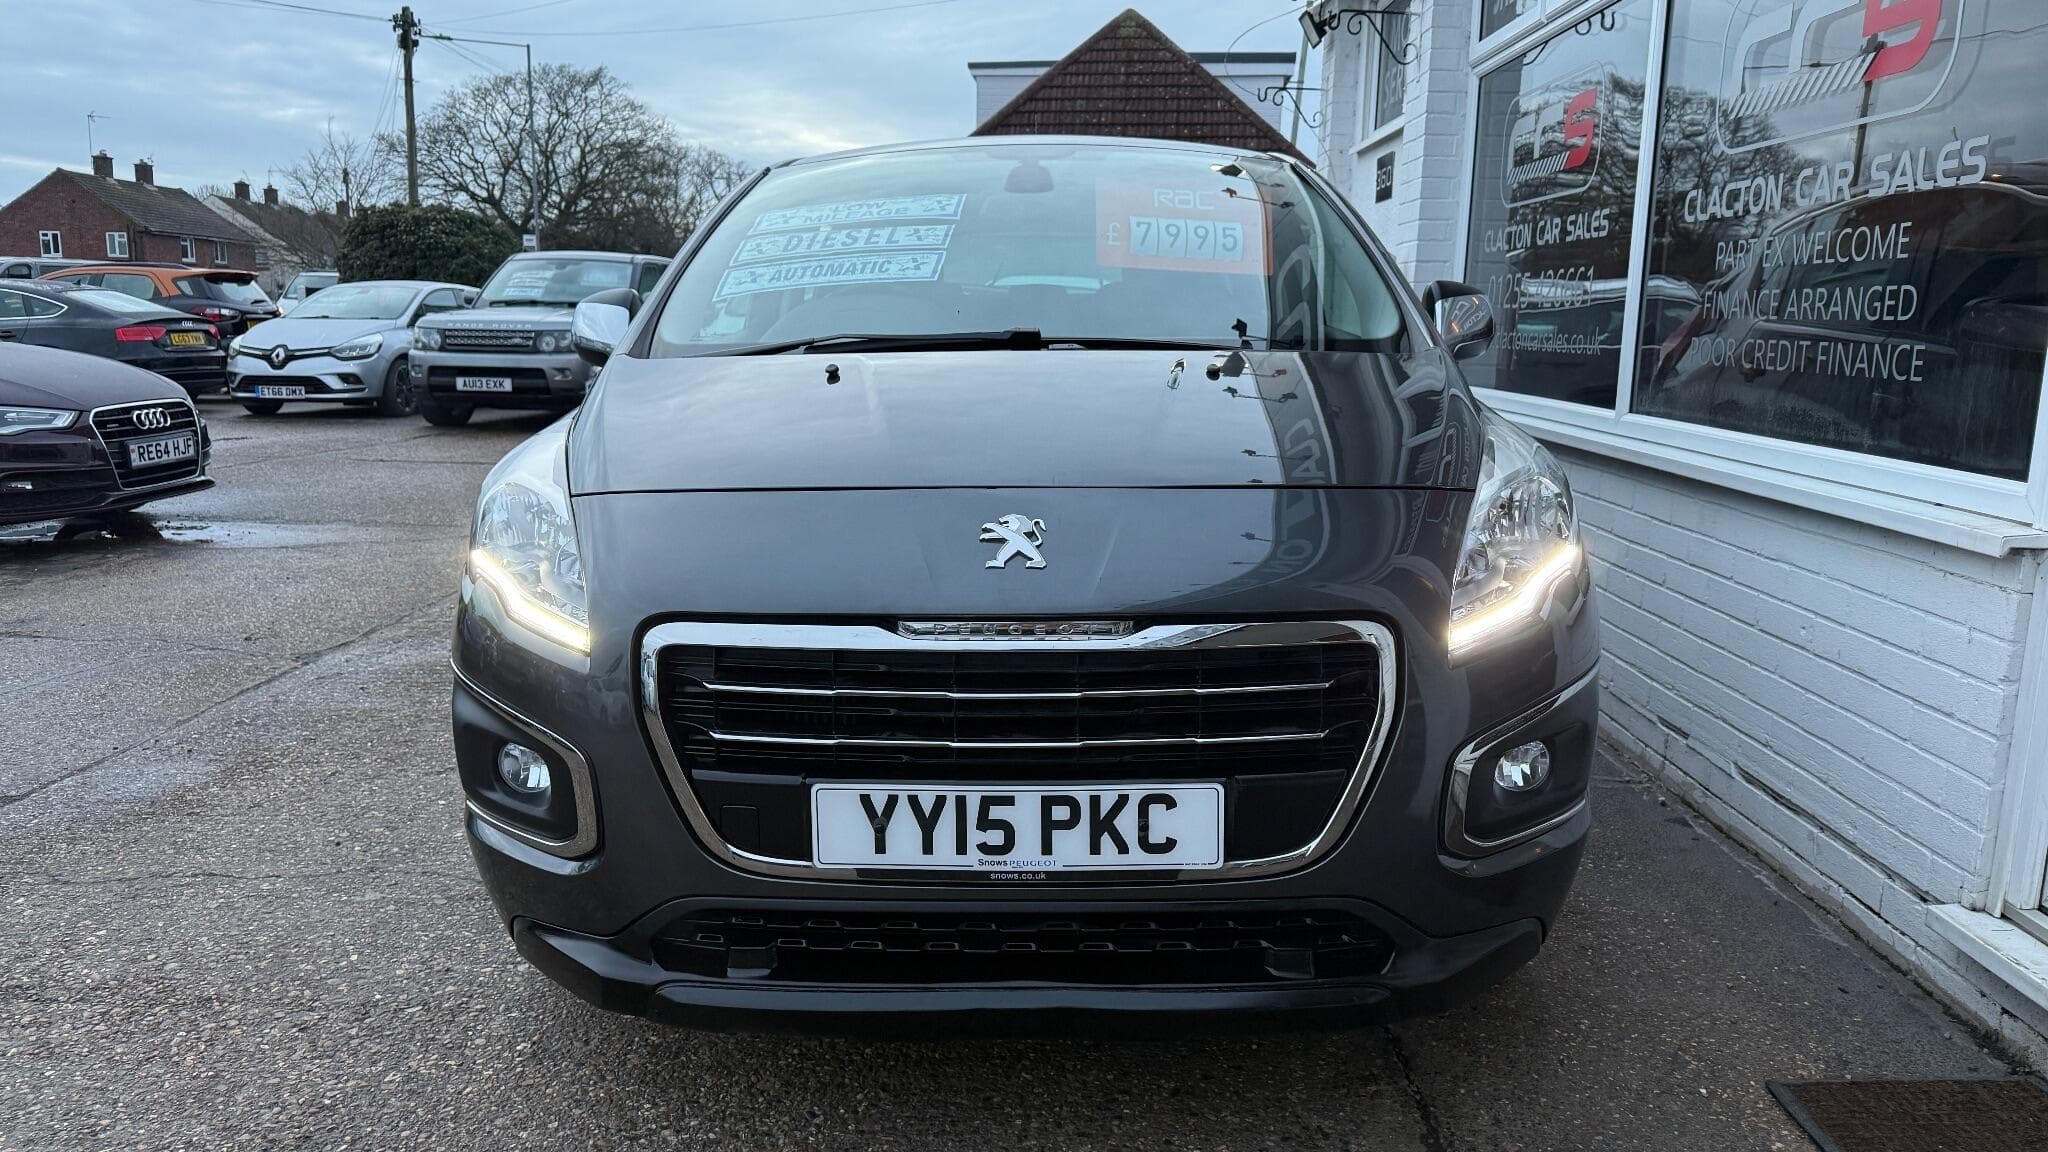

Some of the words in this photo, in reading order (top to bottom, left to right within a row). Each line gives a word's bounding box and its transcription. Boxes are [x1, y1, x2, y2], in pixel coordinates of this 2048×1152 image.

[1684, 173, 1784, 223] CLACTON
[1796, 161, 1855, 206] CAR
[1868, 134, 1991, 198] SALES
[802, 208, 908, 224] MILEAGE
[831, 200, 887, 212] LOW
[782, 227, 900, 252] DIESEL
[1484, 223, 1533, 252] CLACTON
[1536, 217, 1561, 246] CAR
[1566, 207, 1610, 242] SALES
[1715, 237, 1760, 271] PART
[1762, 234, 1789, 268] EX
[1793, 221, 1913, 266] WELCOME
[768, 259, 892, 283] AUTOMATIC
[1488, 271, 1531, 309] 01255
[1703, 287, 1780, 321] FINANCE
[1784, 284, 1918, 322] ARRANGED
[1689, 336, 1735, 368] POOR
[1742, 338, 1811, 372] CREDIT
[1816, 340, 1927, 382] FINANCE
[260, 386, 283, 397] ET66
[286, 387, 304, 397] DMX
[462, 379, 484, 389] AU13
[486, 379, 505, 389] EXK
[137, 441, 171, 463] RE64
[173, 437, 193, 456] HJF
[933, 622, 1095, 636] PEUGEOT
[859, 793, 1016, 856] YY15
[1040, 793, 1178, 855] PKC
[977, 858, 1008, 867] Snows
[990, 871, 1047, 880] snows.co.uk
